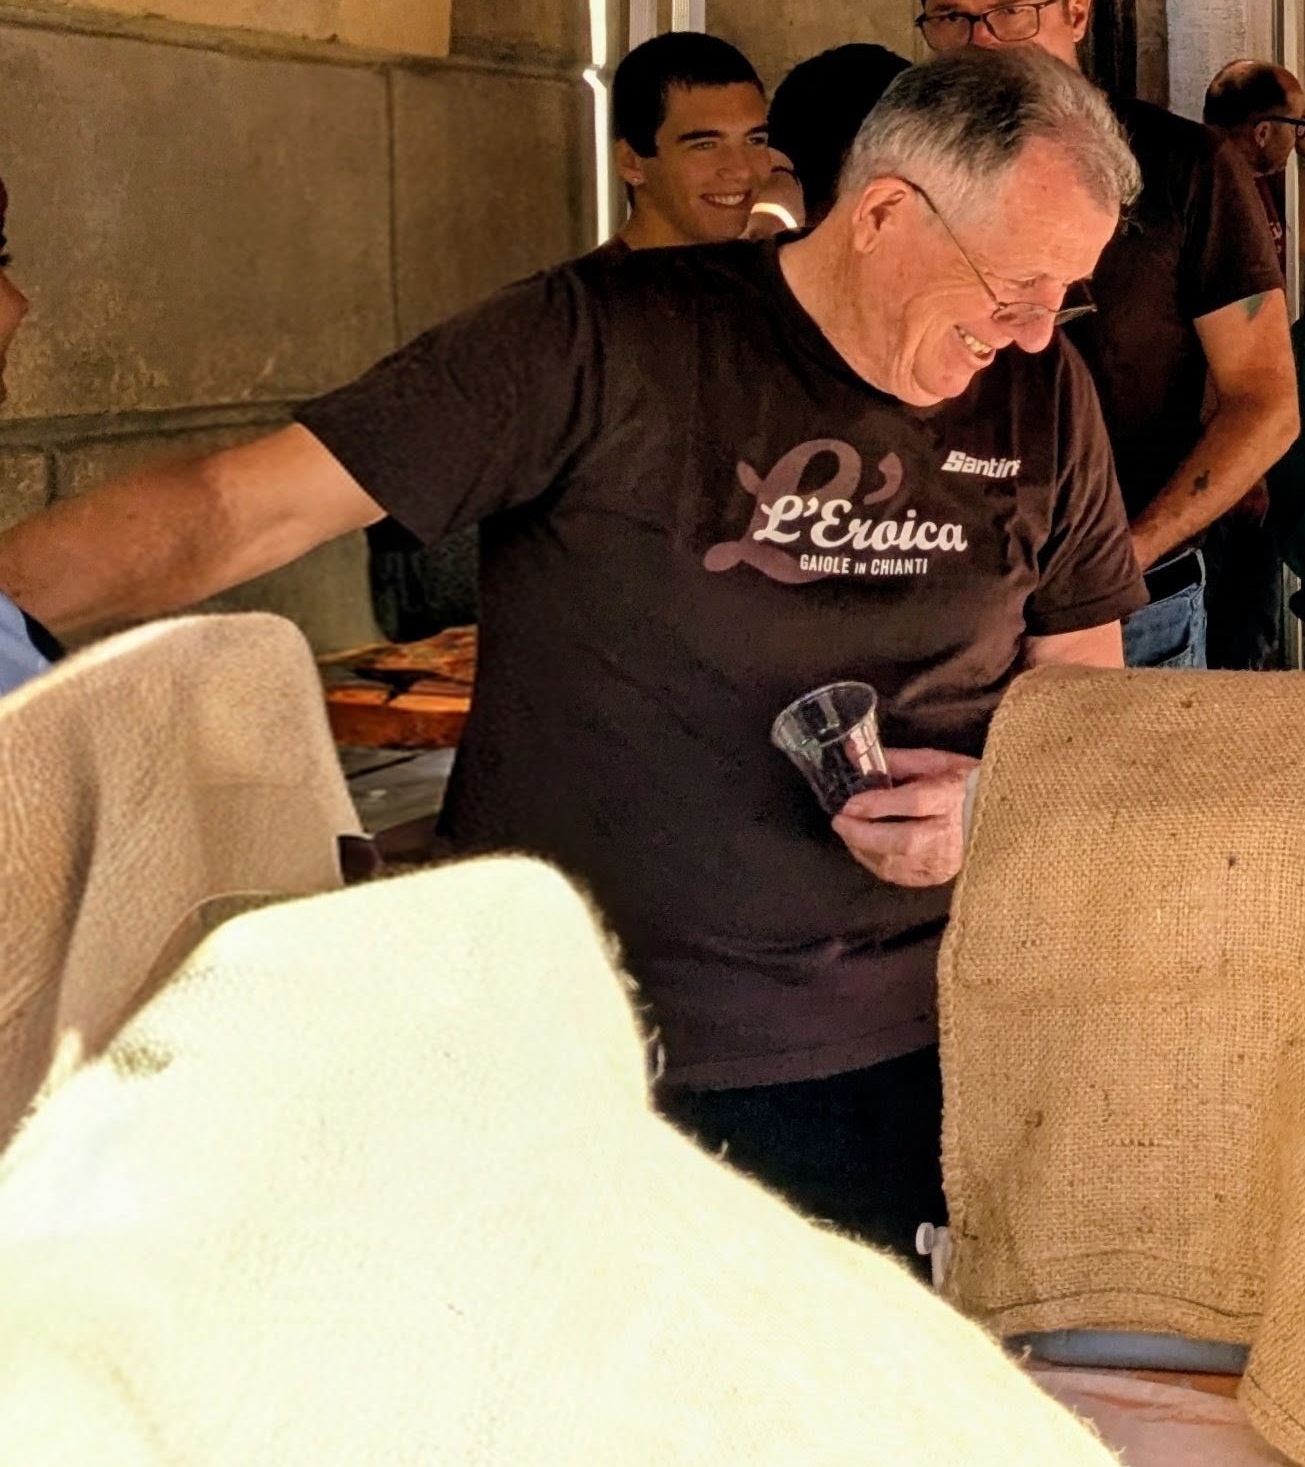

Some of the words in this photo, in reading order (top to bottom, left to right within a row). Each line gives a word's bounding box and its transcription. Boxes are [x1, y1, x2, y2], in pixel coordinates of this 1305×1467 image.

[752, 495, 969, 552] L'Eroica
[800, 554, 852, 575] GAIOLE
[870, 557, 929, 576] CHIANTI
